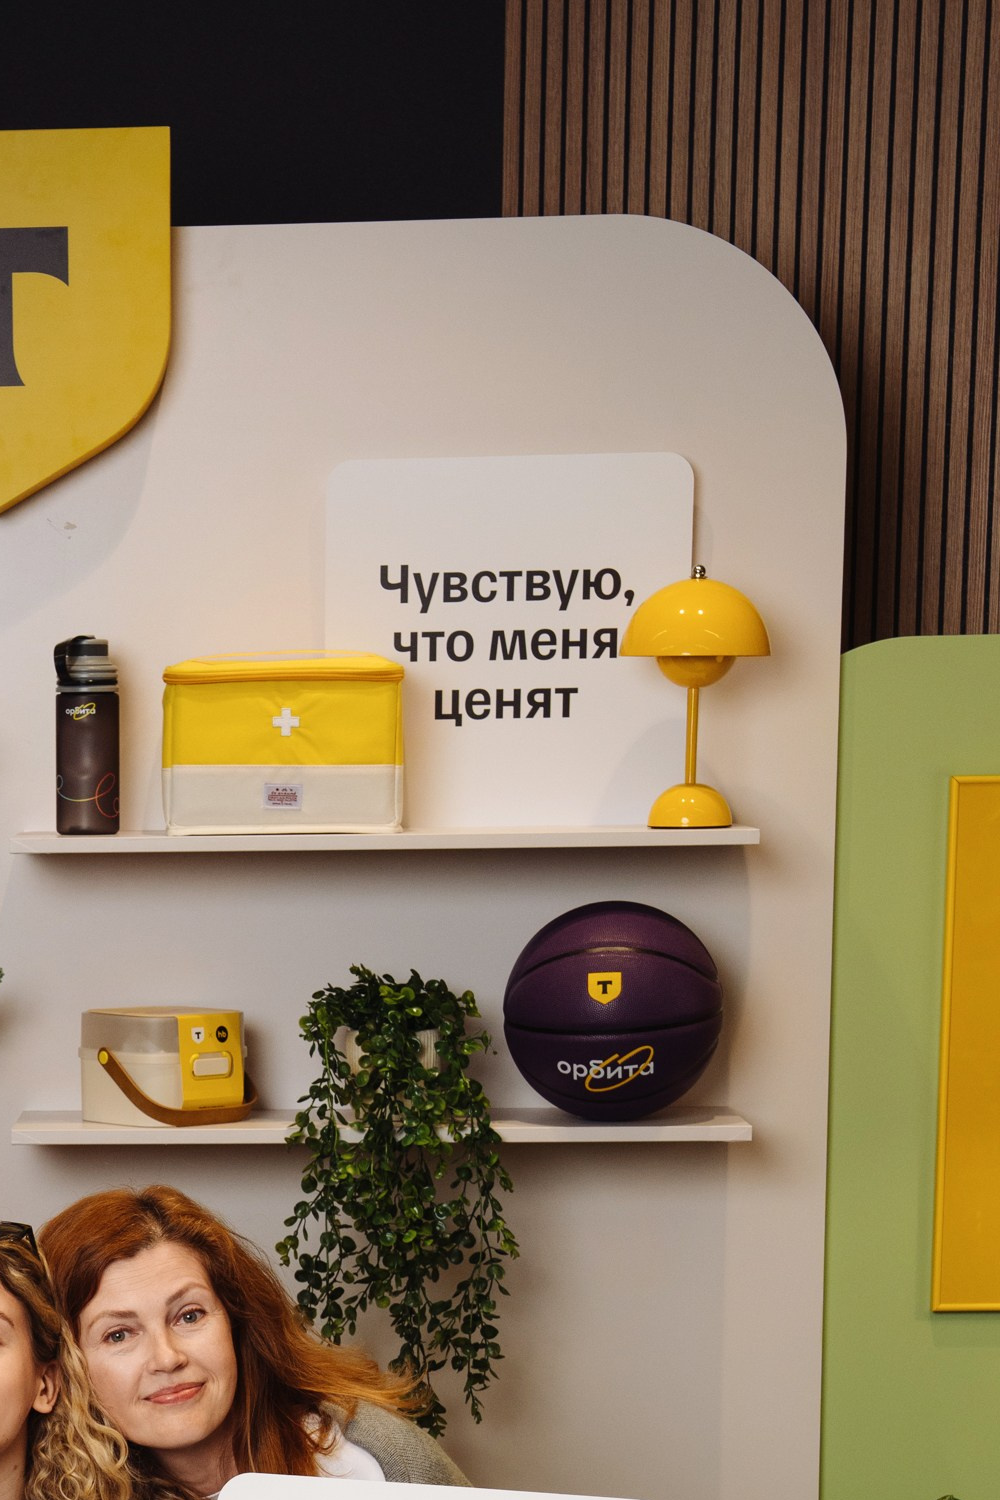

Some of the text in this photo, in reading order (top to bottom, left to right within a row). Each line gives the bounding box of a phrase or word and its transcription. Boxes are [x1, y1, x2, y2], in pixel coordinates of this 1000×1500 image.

[379, 564, 635, 613] Чувствую,
[393, 627, 618, 662] что меня
[434, 687, 578, 726] ценят
